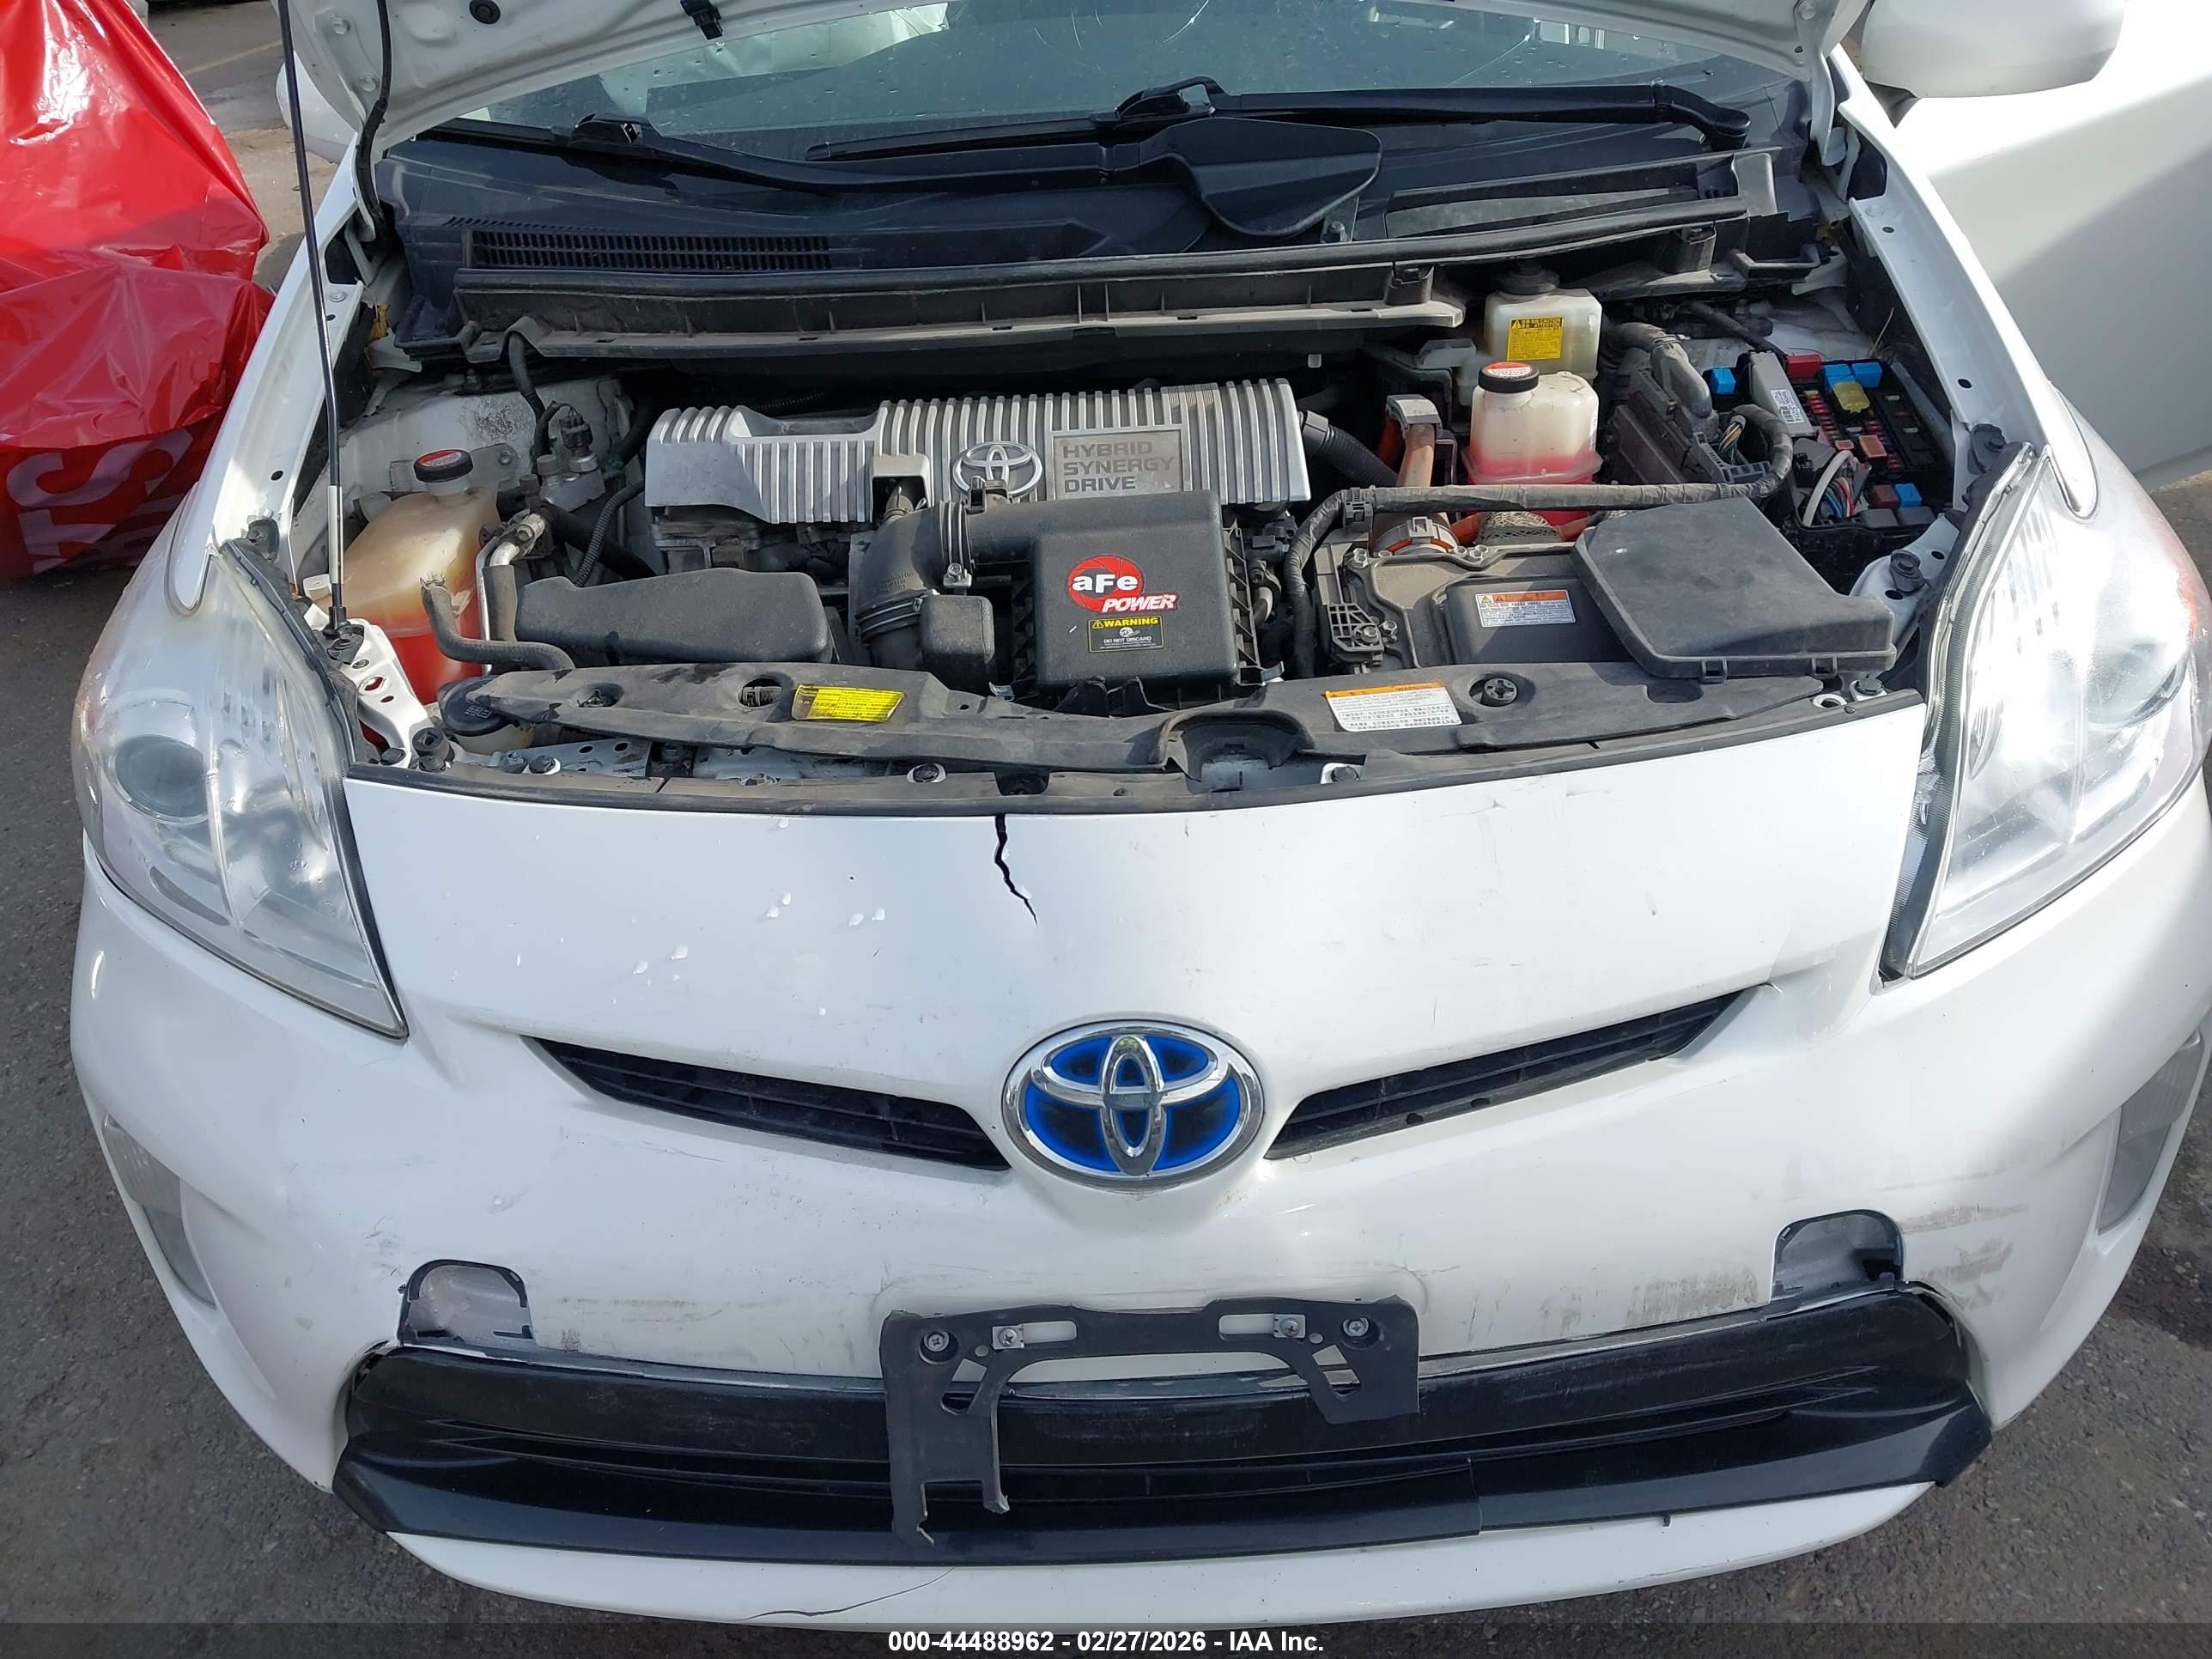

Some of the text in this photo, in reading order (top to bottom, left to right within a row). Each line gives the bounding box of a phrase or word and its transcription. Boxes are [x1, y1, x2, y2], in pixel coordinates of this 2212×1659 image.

[1063, 441, 1152, 458] HYBRID
[1063, 457, 1175, 476] SYNERGY
[1065, 476, 1136, 493] DRIVE
[1072, 574, 1139, 593] aFe
[1102, 594, 1176, 612] POWER
[1103, 617, 1158, 628] WARNING
